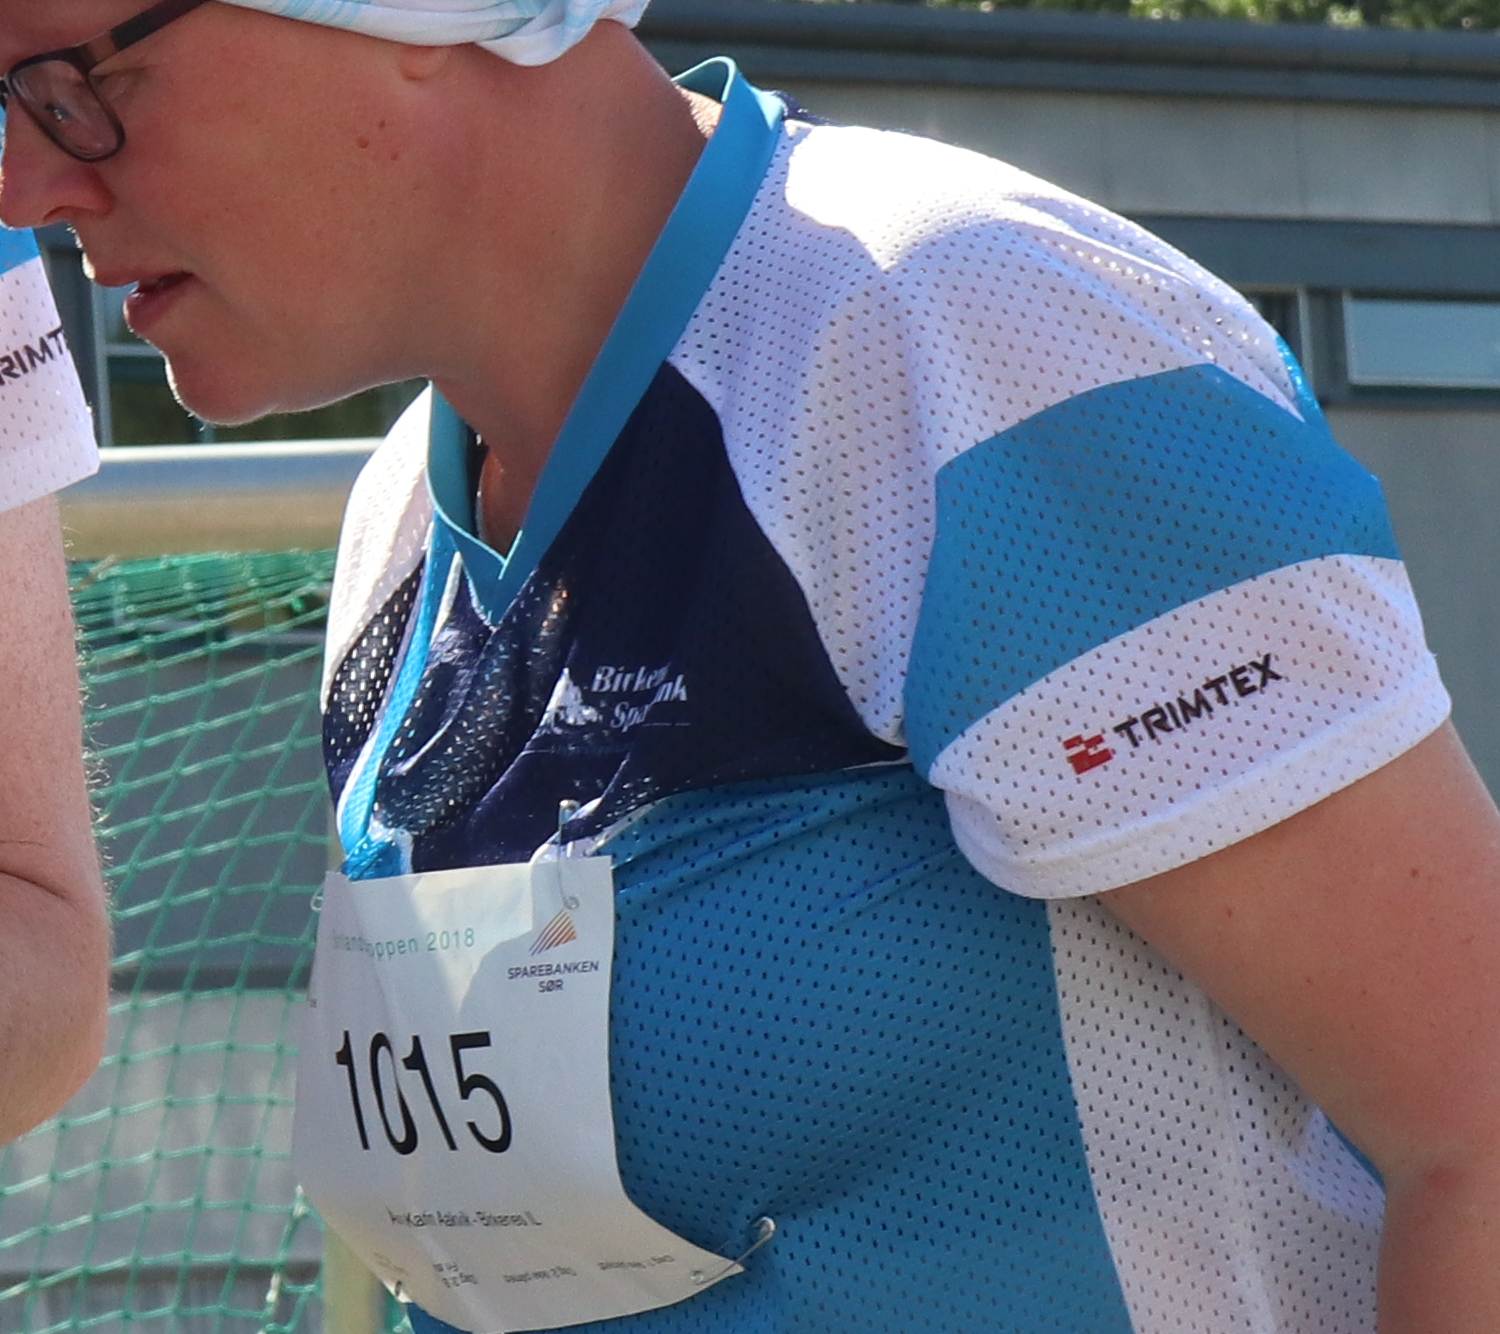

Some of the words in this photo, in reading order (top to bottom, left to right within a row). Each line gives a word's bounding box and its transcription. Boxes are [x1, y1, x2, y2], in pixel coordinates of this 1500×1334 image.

[1112, 652, 1283, 749] TRIMTEX
[426, 927, 476, 952] 2018
[506, 959, 600, 981] SPAREBANKEN
[538, 979, 564, 993] SØR
[335, 1029, 512, 1155] 1015
